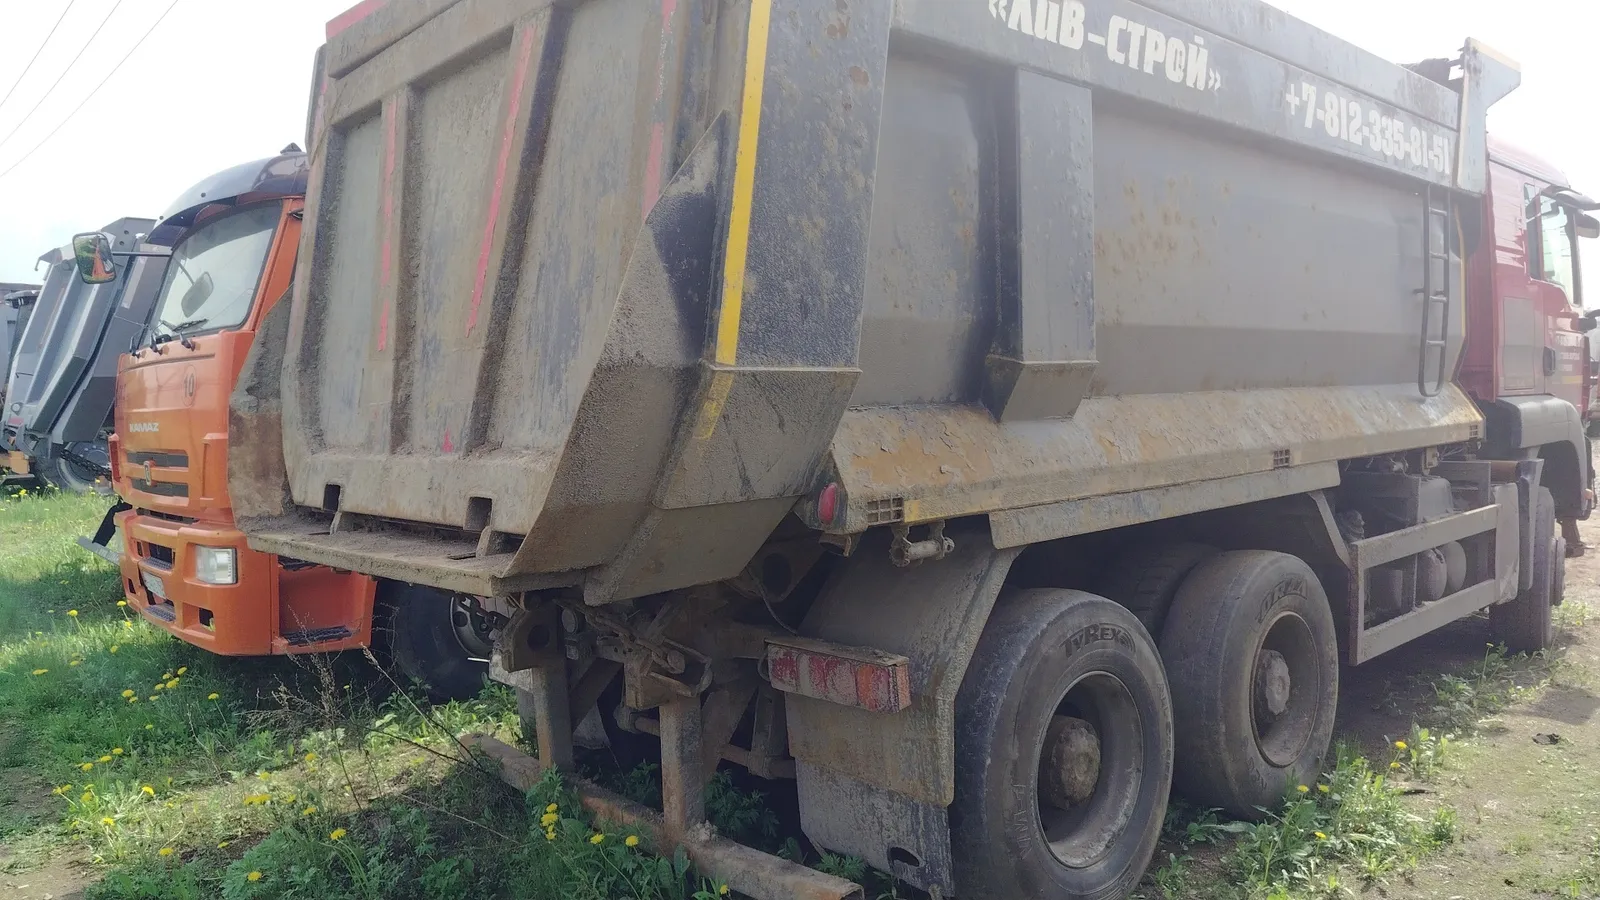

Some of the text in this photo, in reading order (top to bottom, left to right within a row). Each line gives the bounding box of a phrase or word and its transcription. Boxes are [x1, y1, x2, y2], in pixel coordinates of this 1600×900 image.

[1286, 82, 1450, 175] +7-812-335-81-51
[184, 373, 195, 397] 10
[129, 422, 159, 433] KAMAZ
